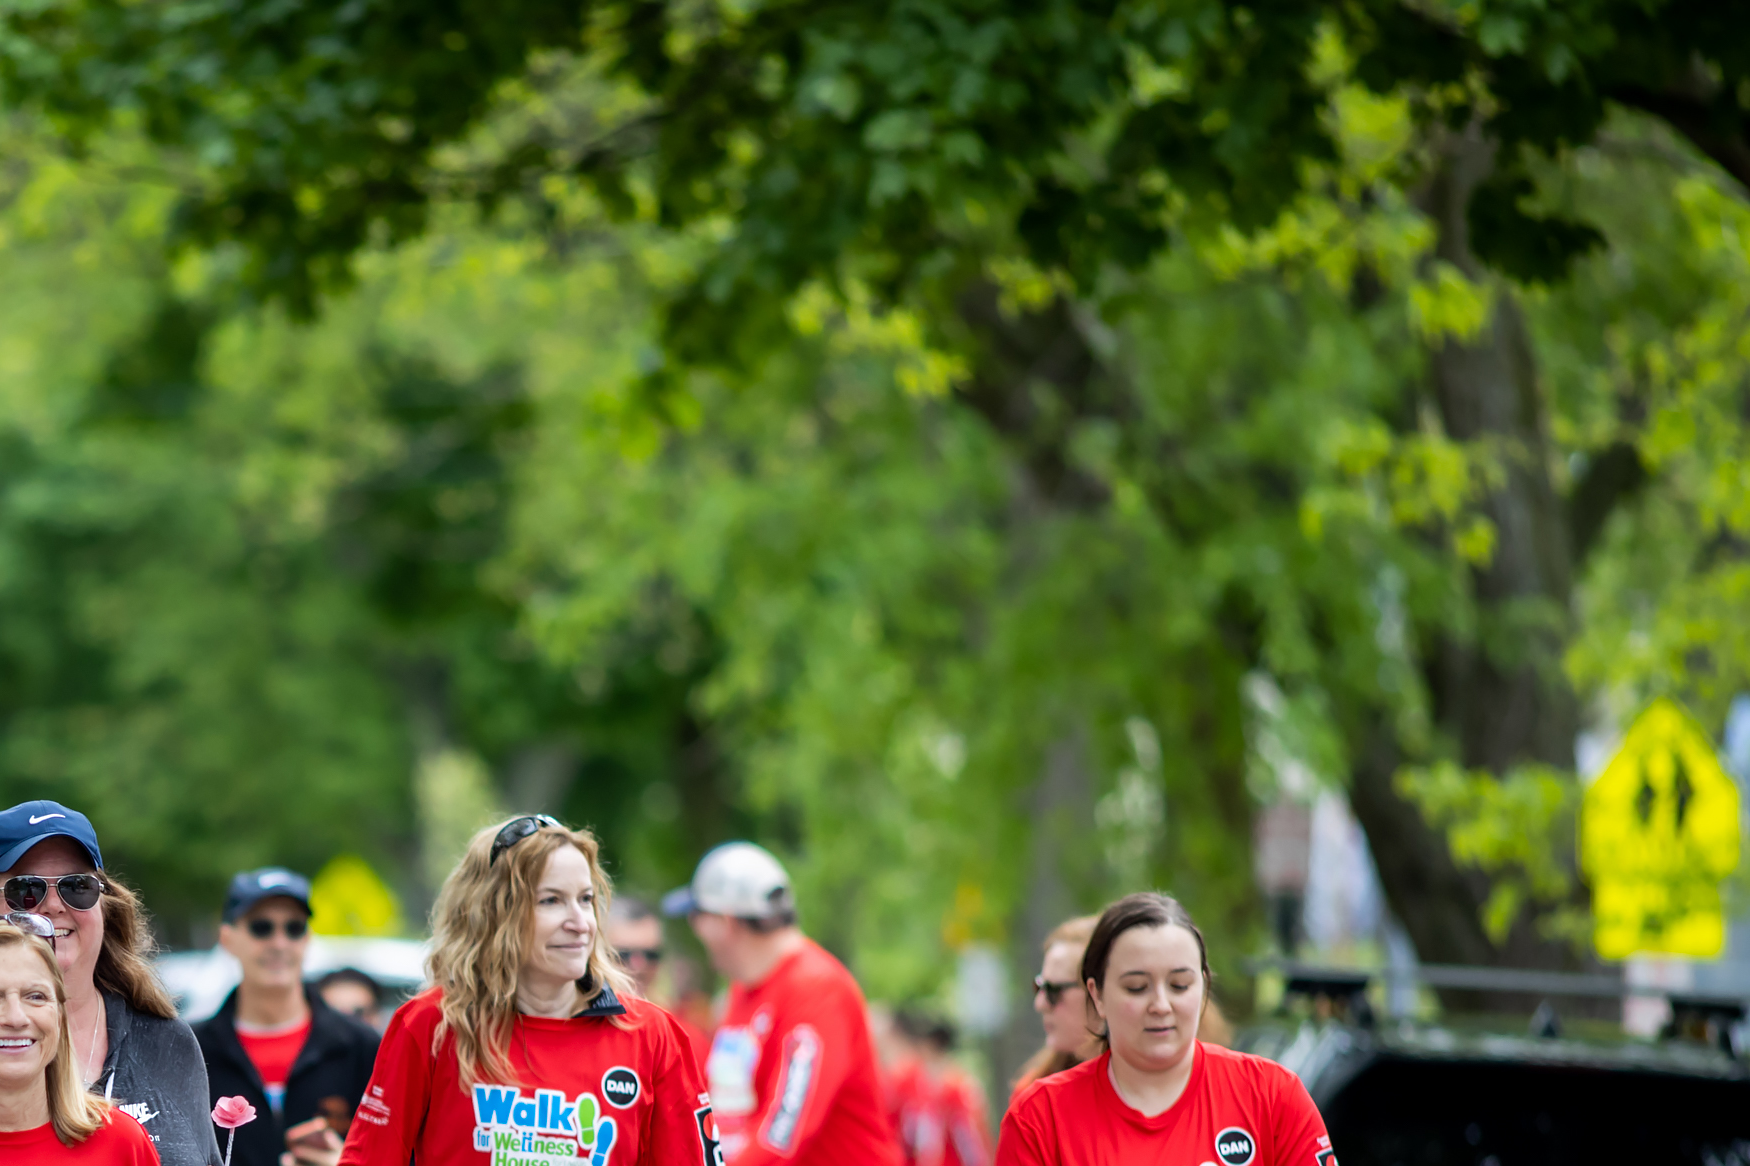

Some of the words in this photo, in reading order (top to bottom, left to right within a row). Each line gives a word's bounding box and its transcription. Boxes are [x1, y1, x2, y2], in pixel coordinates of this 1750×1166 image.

[607, 1081, 635, 1095] DAN
[475, 1088, 575, 1131] Walk
[477, 1130, 490, 1147] for
[494, 1132, 573, 1156] Wellness
[1220, 1141, 1250, 1156] DAN
